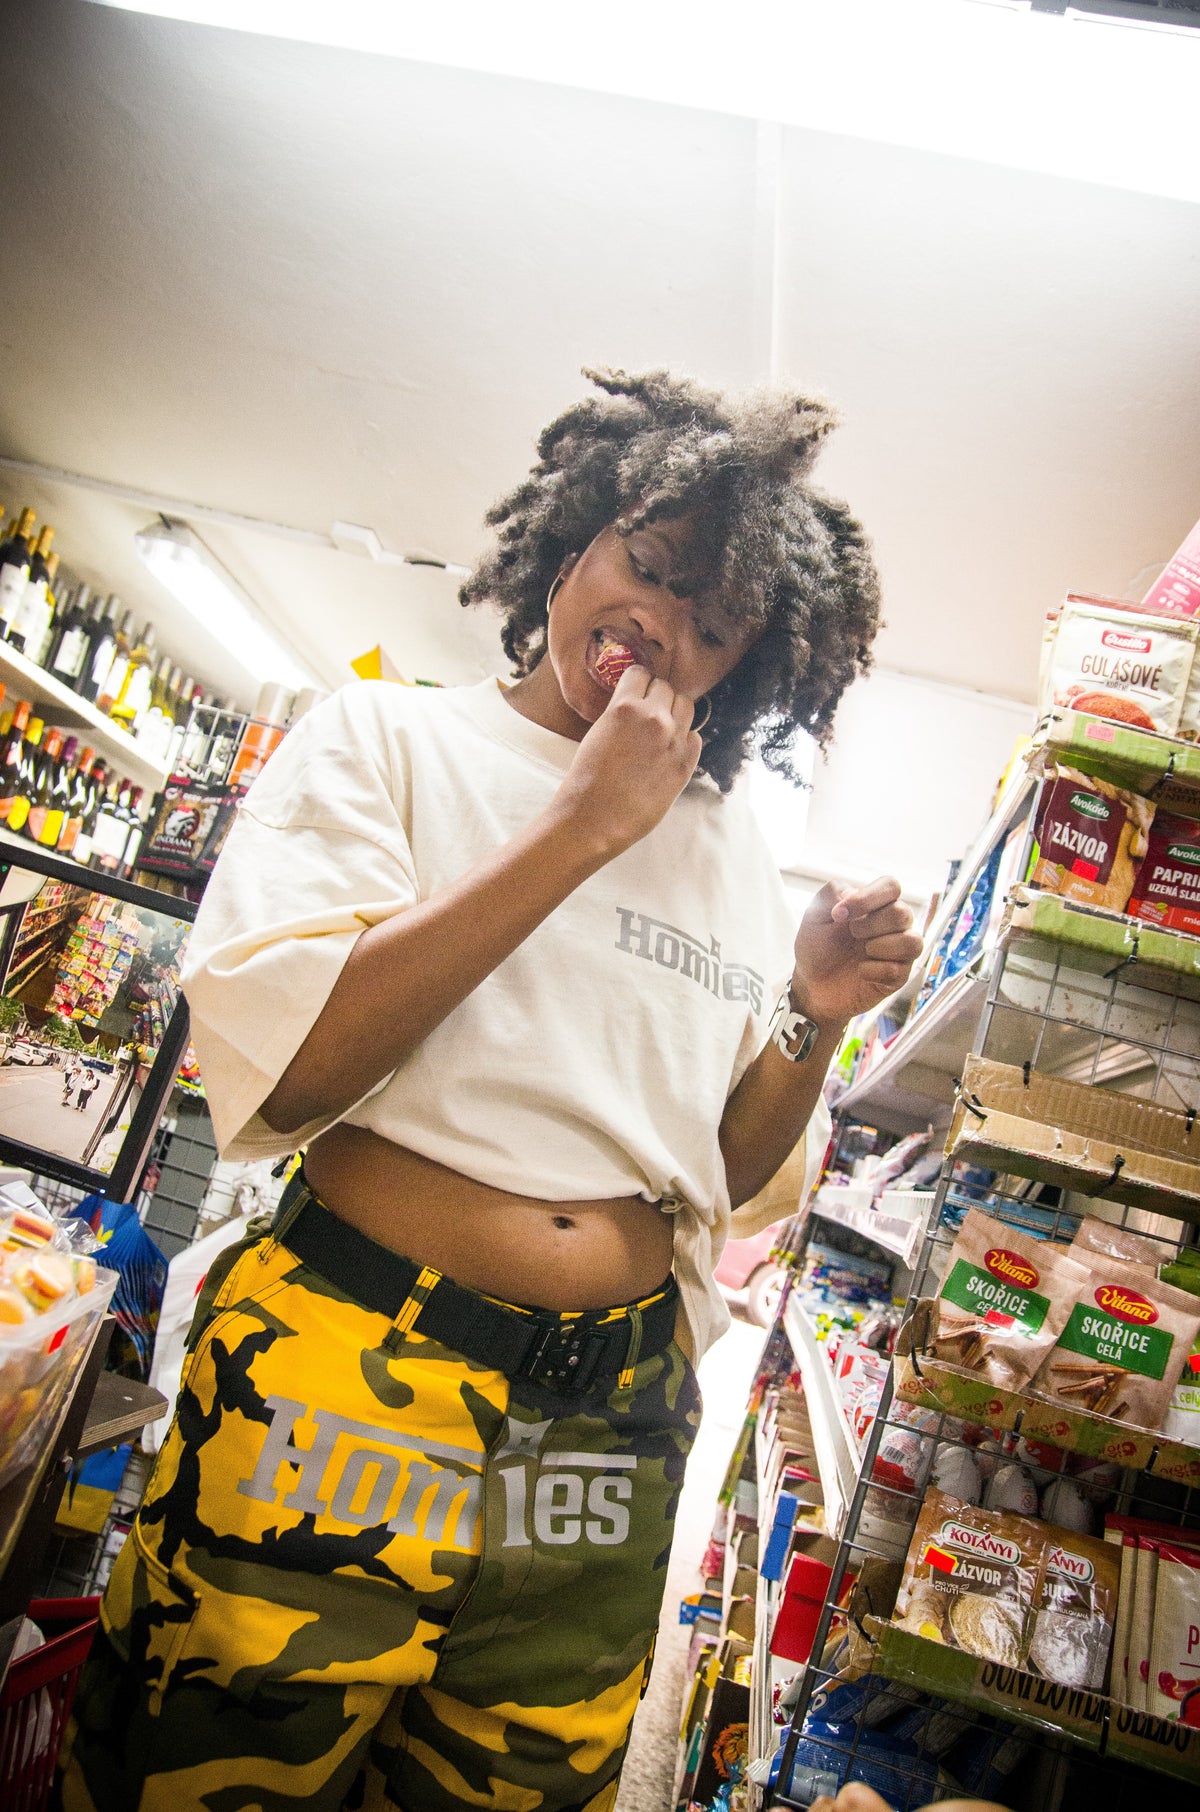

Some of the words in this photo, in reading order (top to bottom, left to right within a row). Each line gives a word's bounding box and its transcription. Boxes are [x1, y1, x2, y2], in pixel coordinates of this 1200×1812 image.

[1081, 655, 1163, 691] GULÁŠOVÉ
[1070, 794, 1110, 818] Avokádo
[1052, 821, 1109, 864] ZÁZVOR
[1148, 883, 1178, 897] UZENÁ
[1152, 866, 1200, 889] PAPRI
[614, 906, 765, 1016] Homies
[990, 1250, 1037, 1285] Vitana
[966, 1276, 1030, 1317] SKOŘICE
[1099, 1287, 1155, 1320] Vitana
[1081, 1316, 1151, 1354] SKOŘICE
[1096, 1342, 1122, 1360] CELÁ
[237, 1395, 637, 1549] Homies
[950, 1527, 1013, 1559] KOTÁNYI
[1049, 1549, 1085, 1577] ÁNYI
